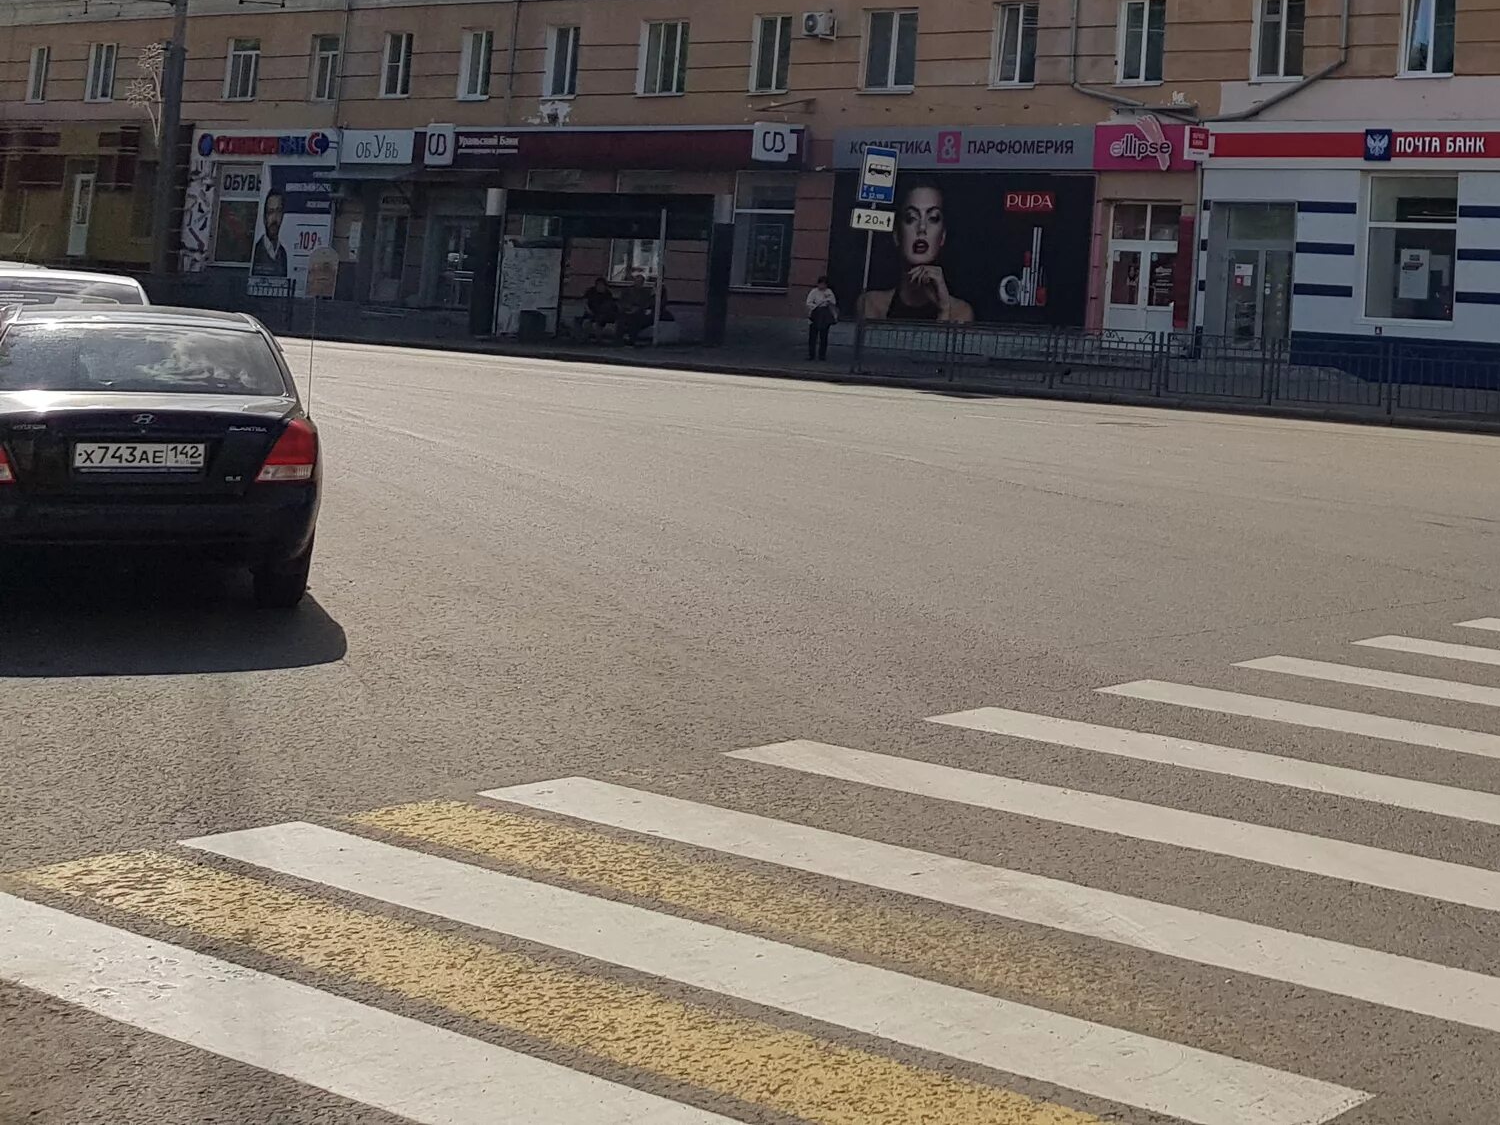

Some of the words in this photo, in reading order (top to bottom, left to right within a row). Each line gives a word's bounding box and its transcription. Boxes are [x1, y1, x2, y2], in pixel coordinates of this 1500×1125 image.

[968, 140, 1075, 155] ПАРФЮМЕРИЯ
[1396, 137, 1440, 153] ПОЧТА
[1446, 137, 1485, 153] БАНК
[1006, 194, 1052, 209] PUPA
[865, 214, 879, 225] 20
[170, 445, 202, 459] 142
